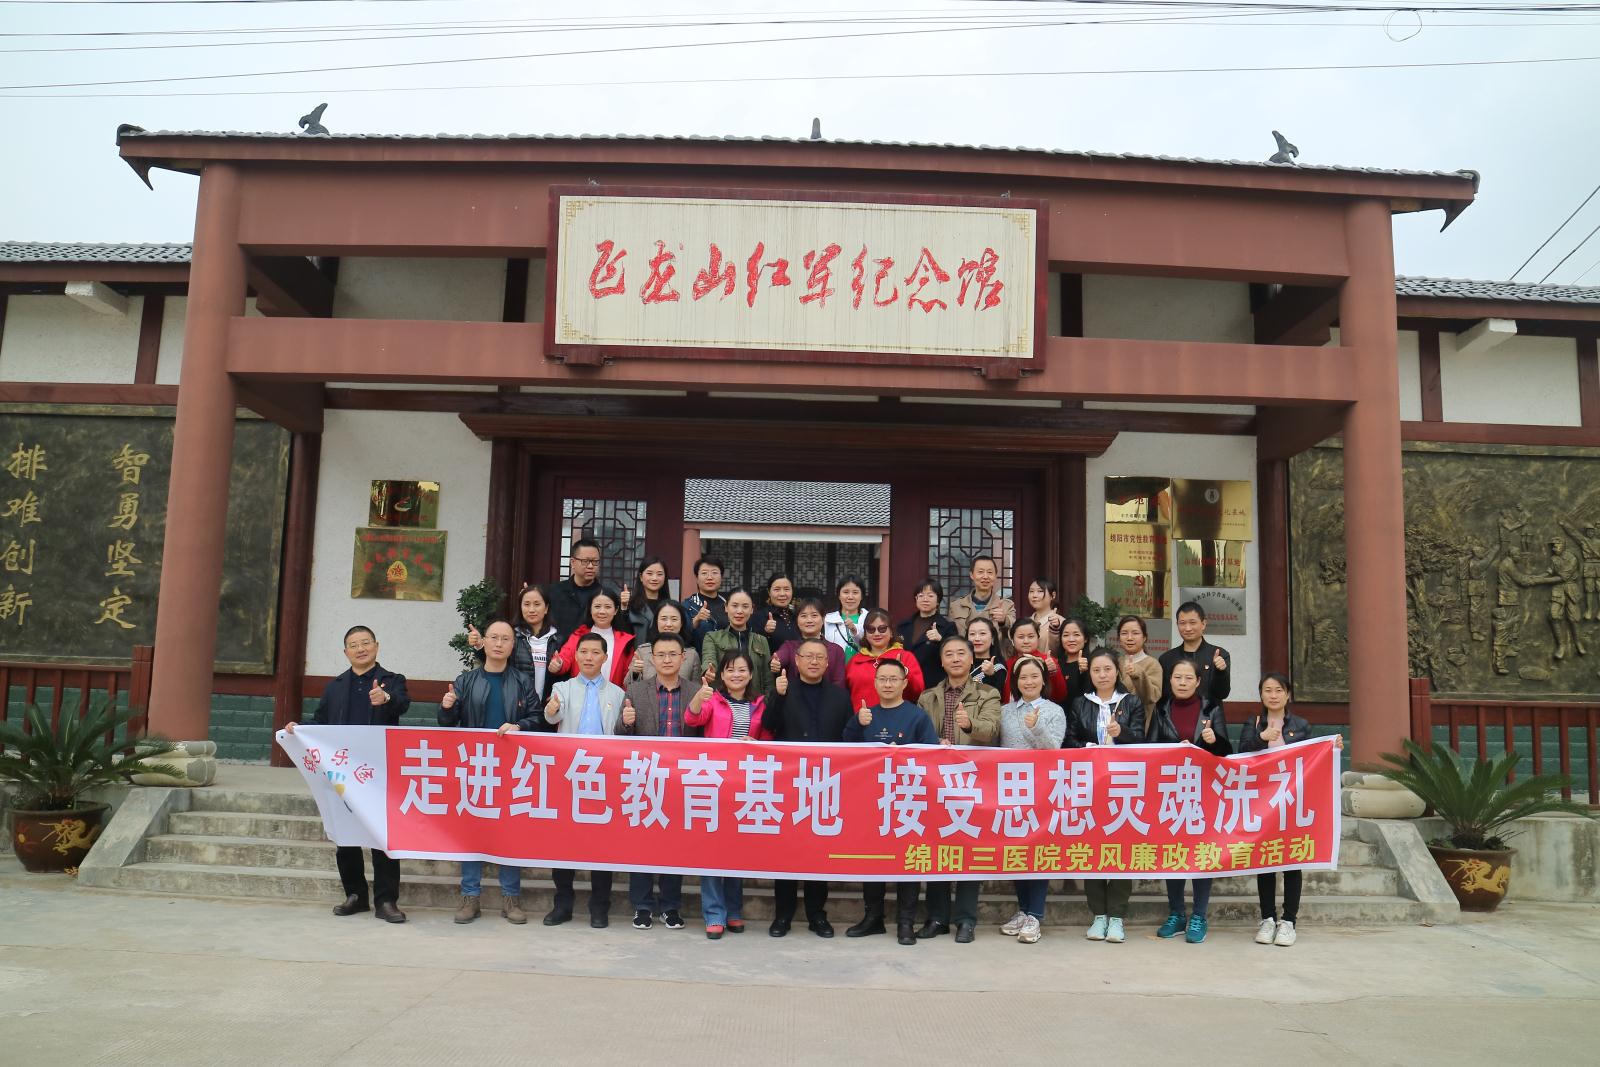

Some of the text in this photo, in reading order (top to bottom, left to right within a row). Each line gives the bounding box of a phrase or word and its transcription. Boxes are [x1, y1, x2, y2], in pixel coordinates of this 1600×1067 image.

[588, 239, 1004, 314] 飞龙山红军纪念馆
[0, 442, 48, 626] 排难创新
[95, 443, 150, 629] 智勇坚定
[399, 739, 1316, 839] 走进红色教育基地 接受思想灵魂洗礼
